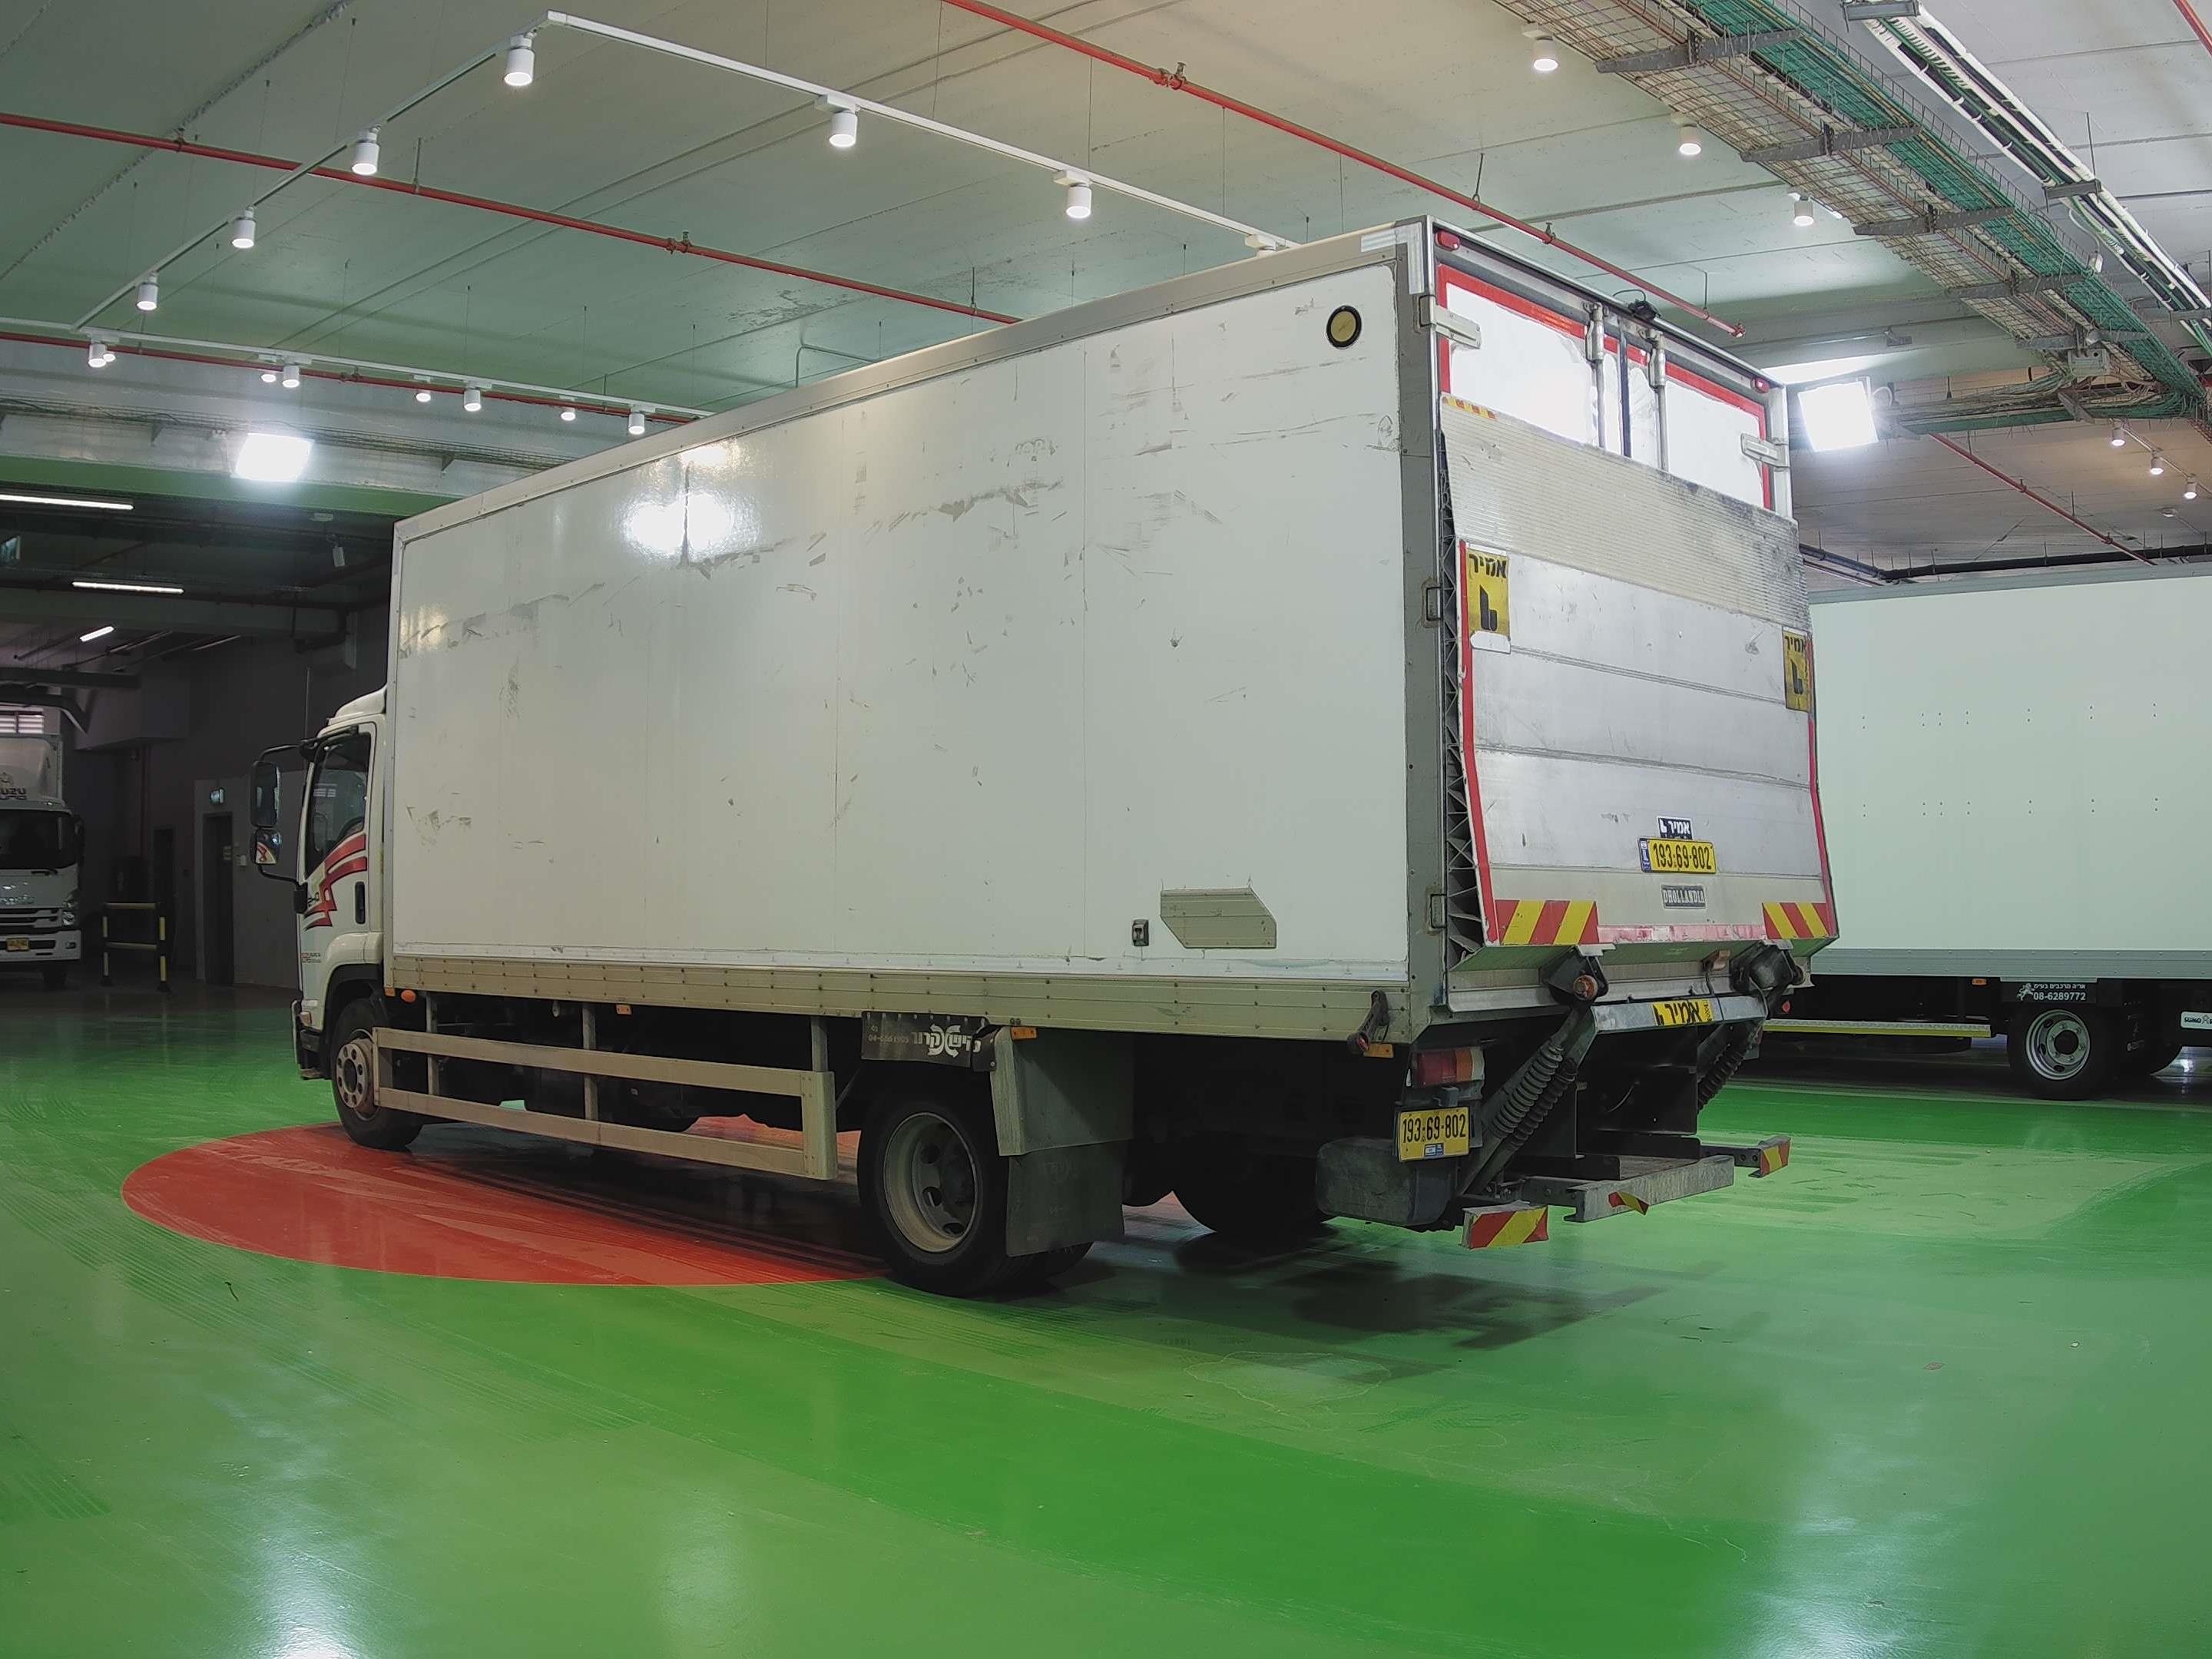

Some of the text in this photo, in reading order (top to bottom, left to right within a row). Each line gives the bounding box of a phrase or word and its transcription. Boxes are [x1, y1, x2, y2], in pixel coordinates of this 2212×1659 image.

[1469, 554, 1507, 578] אמיר
[1667, 820, 1690, 835] אמיר
[1663, 889, 1705, 904] DHOLLANDIA
[2033, 992, 2086, 1001] 08-6289772
[1666, 1002, 1702, 1024] אמיר
